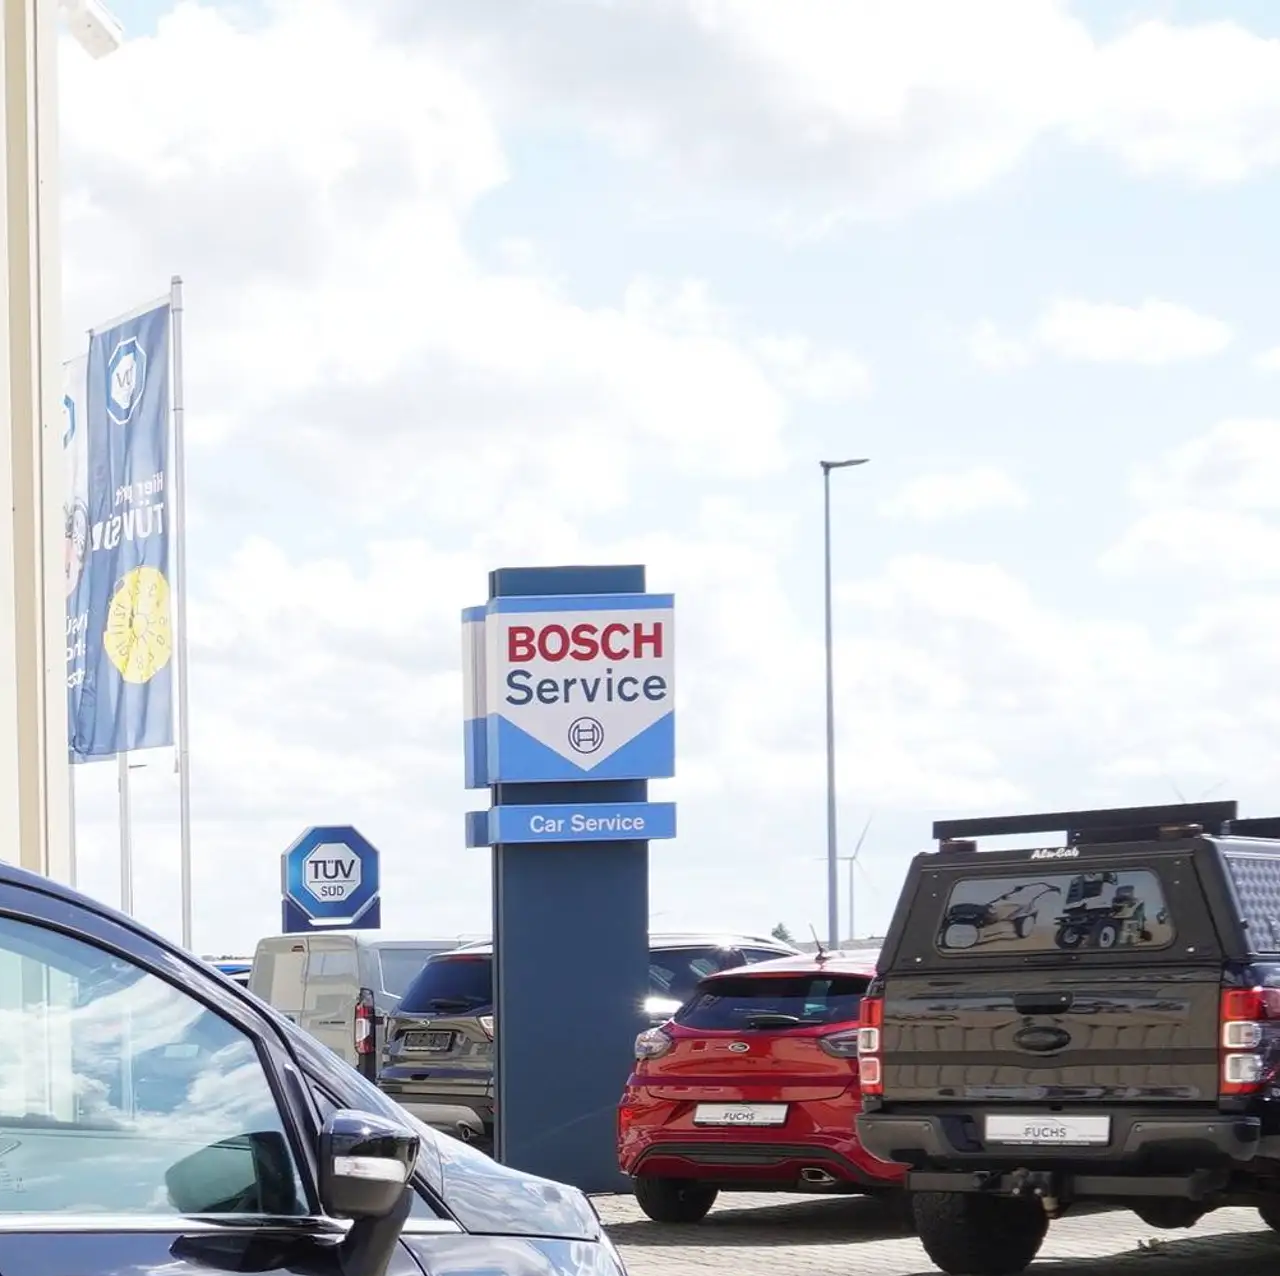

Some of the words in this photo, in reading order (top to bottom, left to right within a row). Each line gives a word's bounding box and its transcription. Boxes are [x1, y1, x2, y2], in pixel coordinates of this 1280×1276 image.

[508, 622, 663, 662] BOSCH
[506, 668, 667, 705] Service
[530, 815, 565, 833] Car
[571, 814, 645, 832] Service
[308, 859, 355, 879] TÜV
[724, 1112, 755, 1121] FUCHS
[1024, 1127, 1067, 1138] FUCHS
